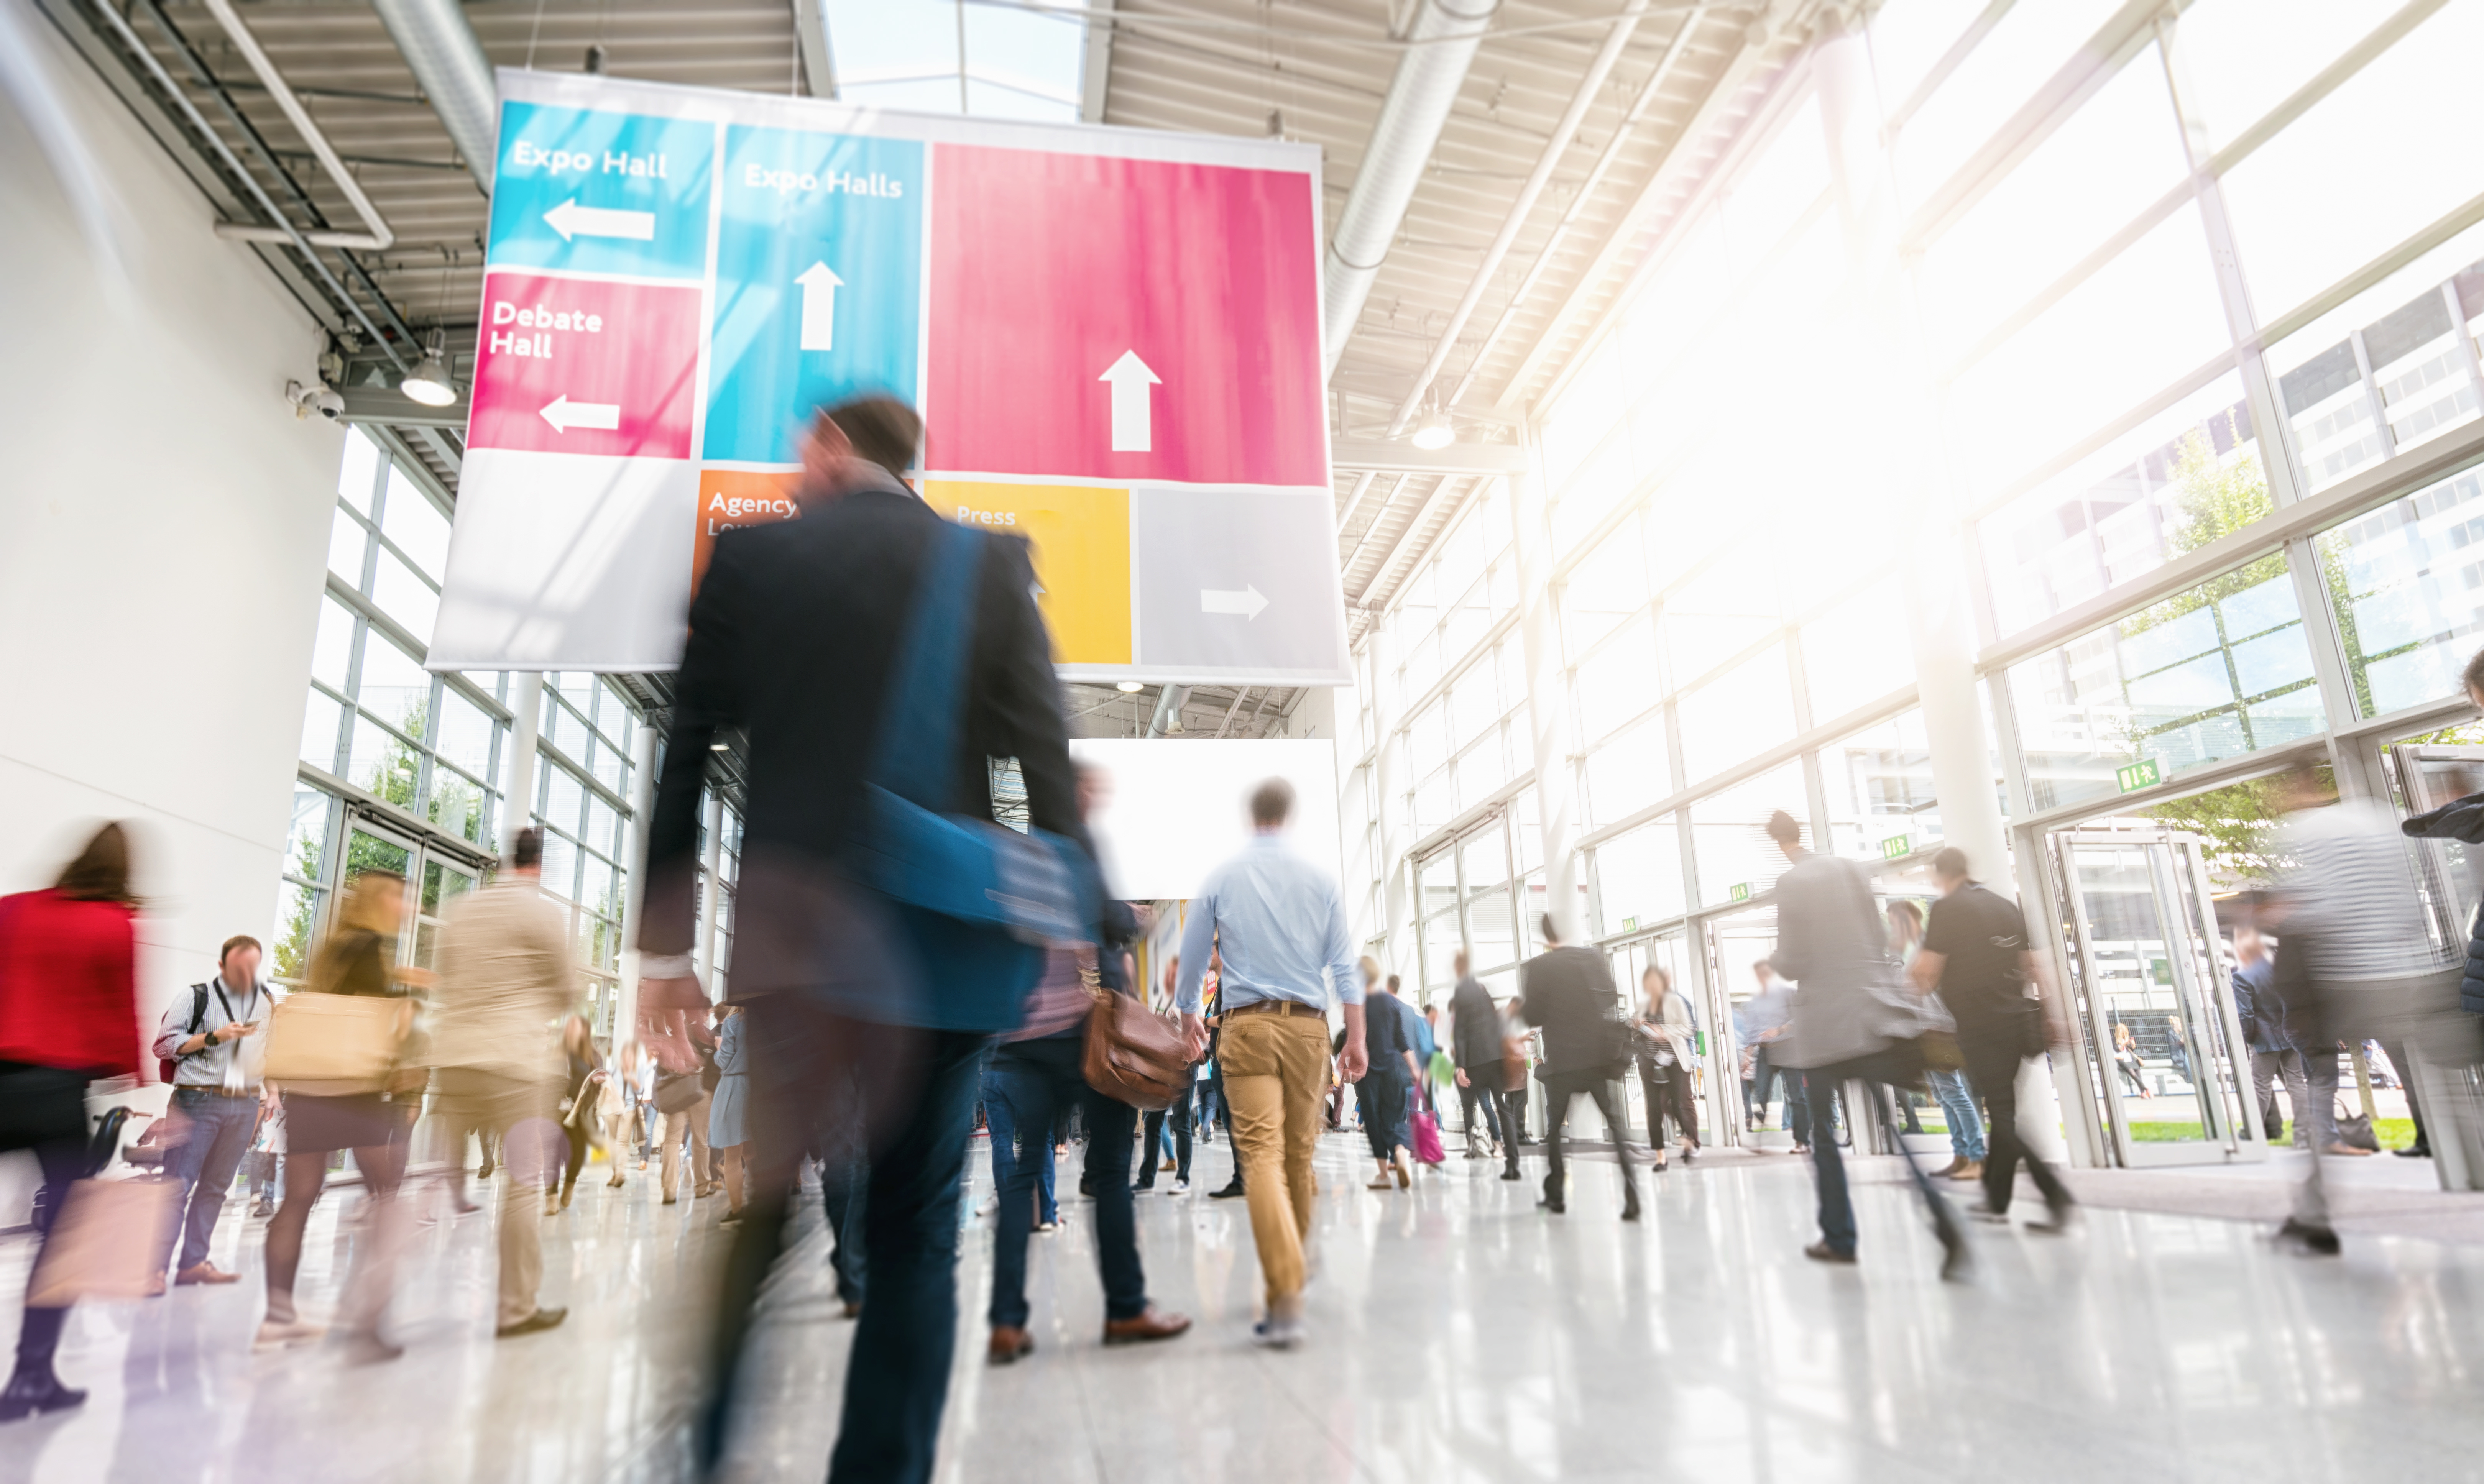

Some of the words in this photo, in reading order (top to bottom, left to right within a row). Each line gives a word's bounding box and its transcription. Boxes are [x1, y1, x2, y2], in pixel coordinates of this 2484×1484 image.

[513, 140, 593, 176] Expo
[602, 149, 667, 179] Hall
[744, 163, 818, 196] Expo
[826, 170, 903, 199] Halls
[493, 301, 603, 332] Debate
[490, 331, 552, 358] Hall
[708, 492, 797, 519] Agency
[958, 506, 1015, 525] Press
